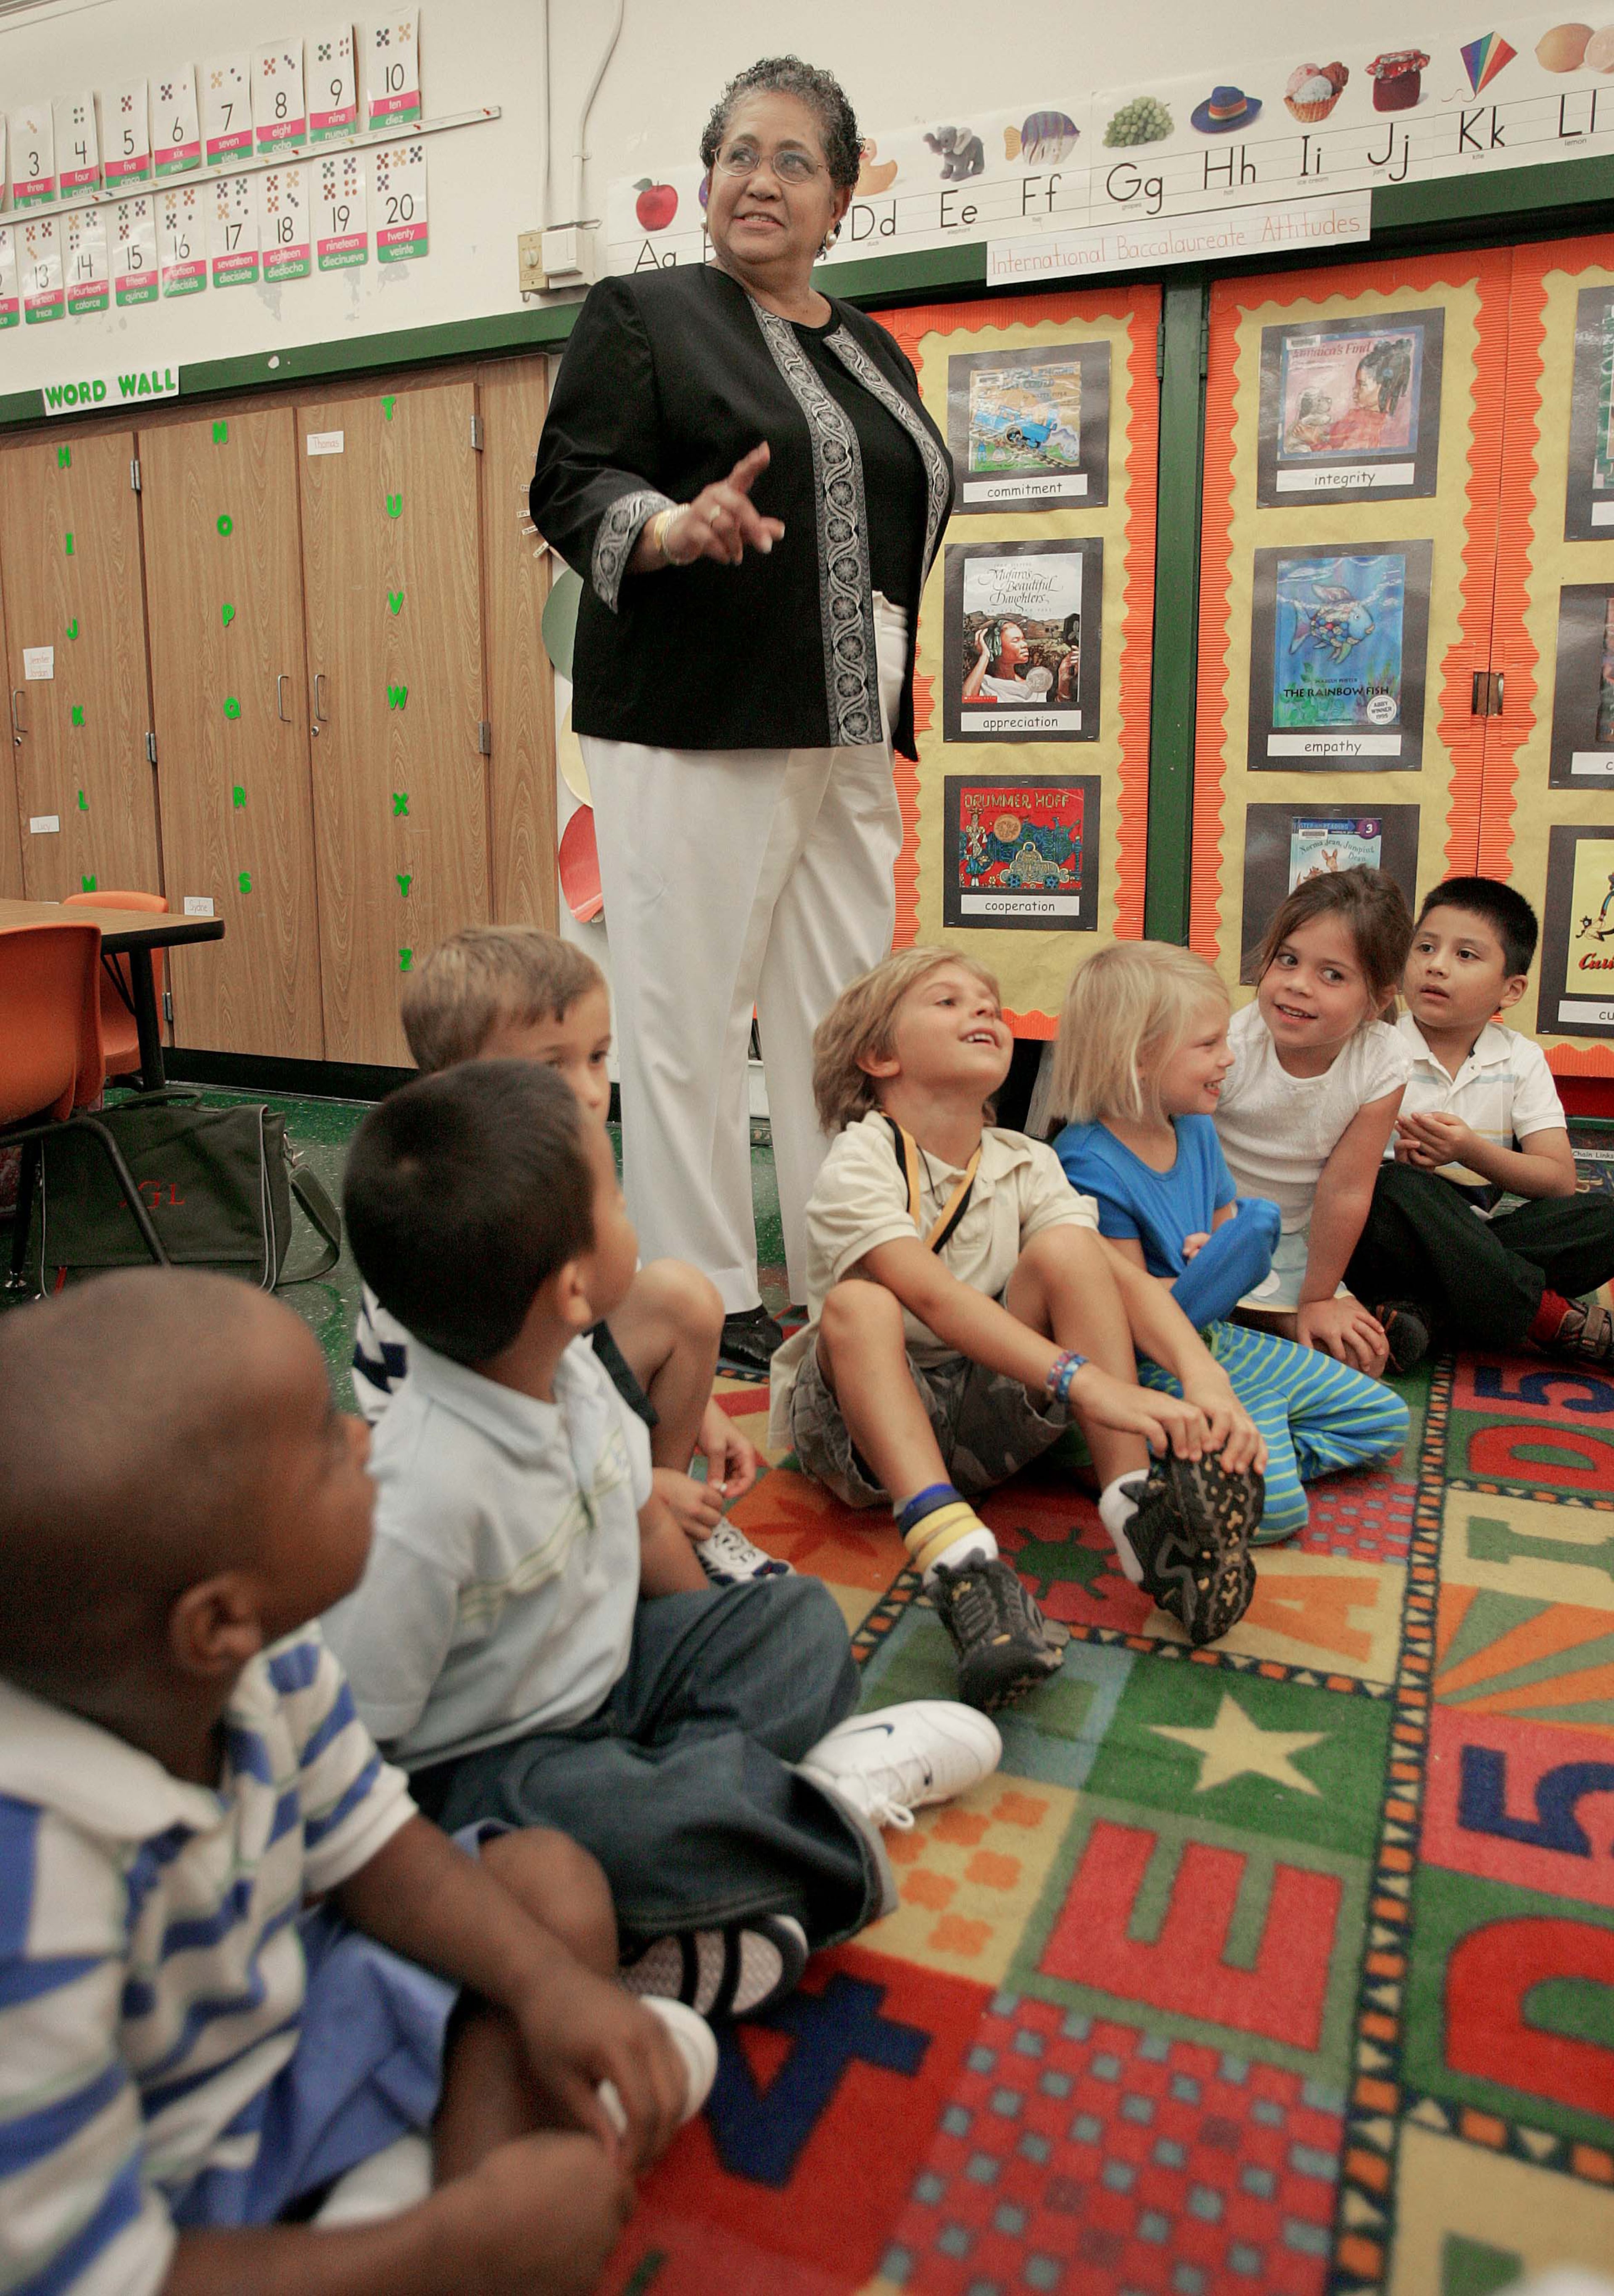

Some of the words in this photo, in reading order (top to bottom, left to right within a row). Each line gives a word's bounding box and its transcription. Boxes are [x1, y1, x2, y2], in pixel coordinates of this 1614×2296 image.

[386, 63, 404, 93] 10
[330, 79, 343, 105] 9
[276, 92, 287, 118] 8
[389, 100, 401, 110] ten
[221, 103, 233, 131] 7
[328, 113, 346, 124] nine
[385, 114, 404, 126] diez
[172, 116, 183, 142] 6
[272, 124, 291, 139] eight
[324, 128, 349, 140] nueve
[1458, 105, 1505, 154] Kk
[75, 140, 87, 164] 4
[124, 129, 134, 155] 5
[218, 137, 239, 150] seven
[272, 141, 292, 151] ocho
[1368, 123, 1409, 181] Jj
[1564, 138, 1587, 147] lemon
[29, 151, 40, 176] 3
[173, 148, 183, 158] six
[123, 161, 136, 171] five
[1204, 145, 1256, 190] Hh
[75, 172, 90, 182] four
[27, 183, 44, 193] three
[1022, 173, 1062, 216] Ff
[1106, 163, 1163, 214] Gg
[332, 205, 350, 232] 19
[385, 194, 414, 224] 20
[941, 189, 978, 228] Ee
[277, 216, 294, 244] 18
[852, 199, 896, 241] Dd
[226, 223, 243, 251] 17
[326, 238, 359, 252] nineteen
[387, 229, 415, 242] twenty
[1116, 222, 1247, 261] Baccalaureate
[1262, 209, 1361, 242] Attitudes
[127, 244, 142, 271] 15
[174, 234, 190, 261] 16
[269, 248, 301, 264] eighteen
[389, 244, 414, 256] veinte
[77, 253, 93, 280] 14
[217, 255, 253, 269] seventeen
[268, 263, 304, 279] dieciocho
[322, 253, 364, 268] diecinueve
[34, 264, 49, 290] 13
[73, 284, 101, 295] fourteen
[125, 289, 149, 304] quince
[75, 299, 100, 311] catorce
[45, 379, 107, 408] WORD
[118, 368, 176, 397] WALL
[381, 396, 396, 420] T
[312, 436, 340, 449] Thomas
[58, 445, 71, 468] H
[1314, 470, 1375, 488] integrity
[987, 482, 1062, 498] commitment
[387, 494, 402, 517] U
[217, 514, 232, 537] O
[388, 592, 404, 614] V
[222, 603, 235, 627] P
[66, 619, 79, 639] J
[387, 685, 407, 709] W
[1307, 687, 1364, 697] RAINBOW
[1366, 686, 1390, 695] FISH
[72, 706, 84, 726] K
[223, 697, 241, 719] Q
[983, 716, 1058, 732] appreciation
[1305, 740, 1361, 756] empathy
[79, 790, 88, 810] L
[233, 786, 246, 807] R
[393, 793, 409, 816] X
[965, 793, 1032, 809] DRUMMER
[1035, 792, 1069, 808] HOFF
[1365, 824, 1373, 833] 3
[1299, 841, 1323, 854] Norma
[238, 872, 251, 893] S
[396, 874, 411, 896] Y
[985, 901, 1055, 914] cooperation
[399, 948, 414, 971] Z
